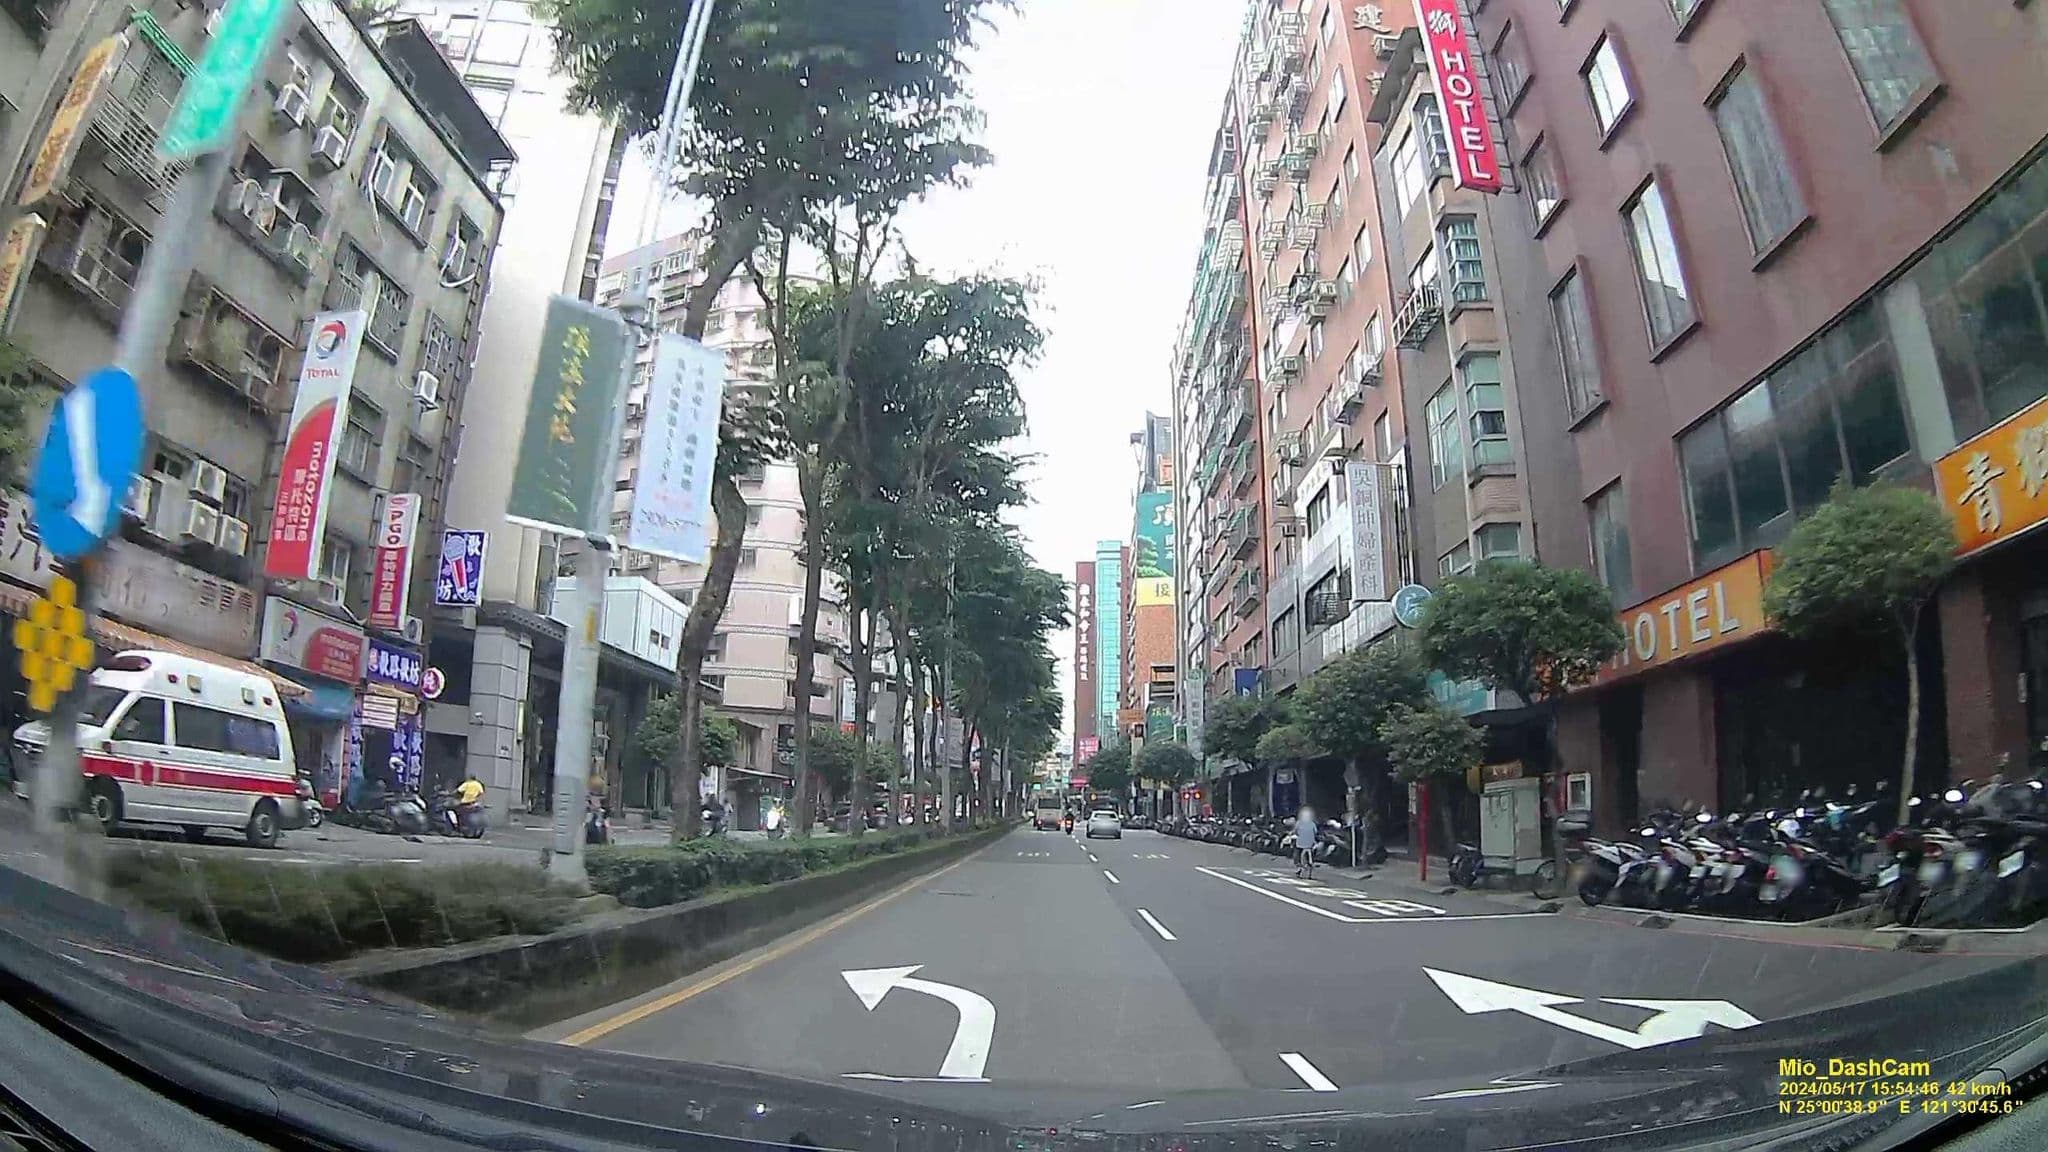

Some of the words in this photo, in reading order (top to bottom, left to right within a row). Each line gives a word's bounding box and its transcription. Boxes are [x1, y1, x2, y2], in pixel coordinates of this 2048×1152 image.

[1440, 48, 1493, 181] HOTEL
[305, 367, 341, 380] TOTAL
[387, 510, 405, 546] PGO
